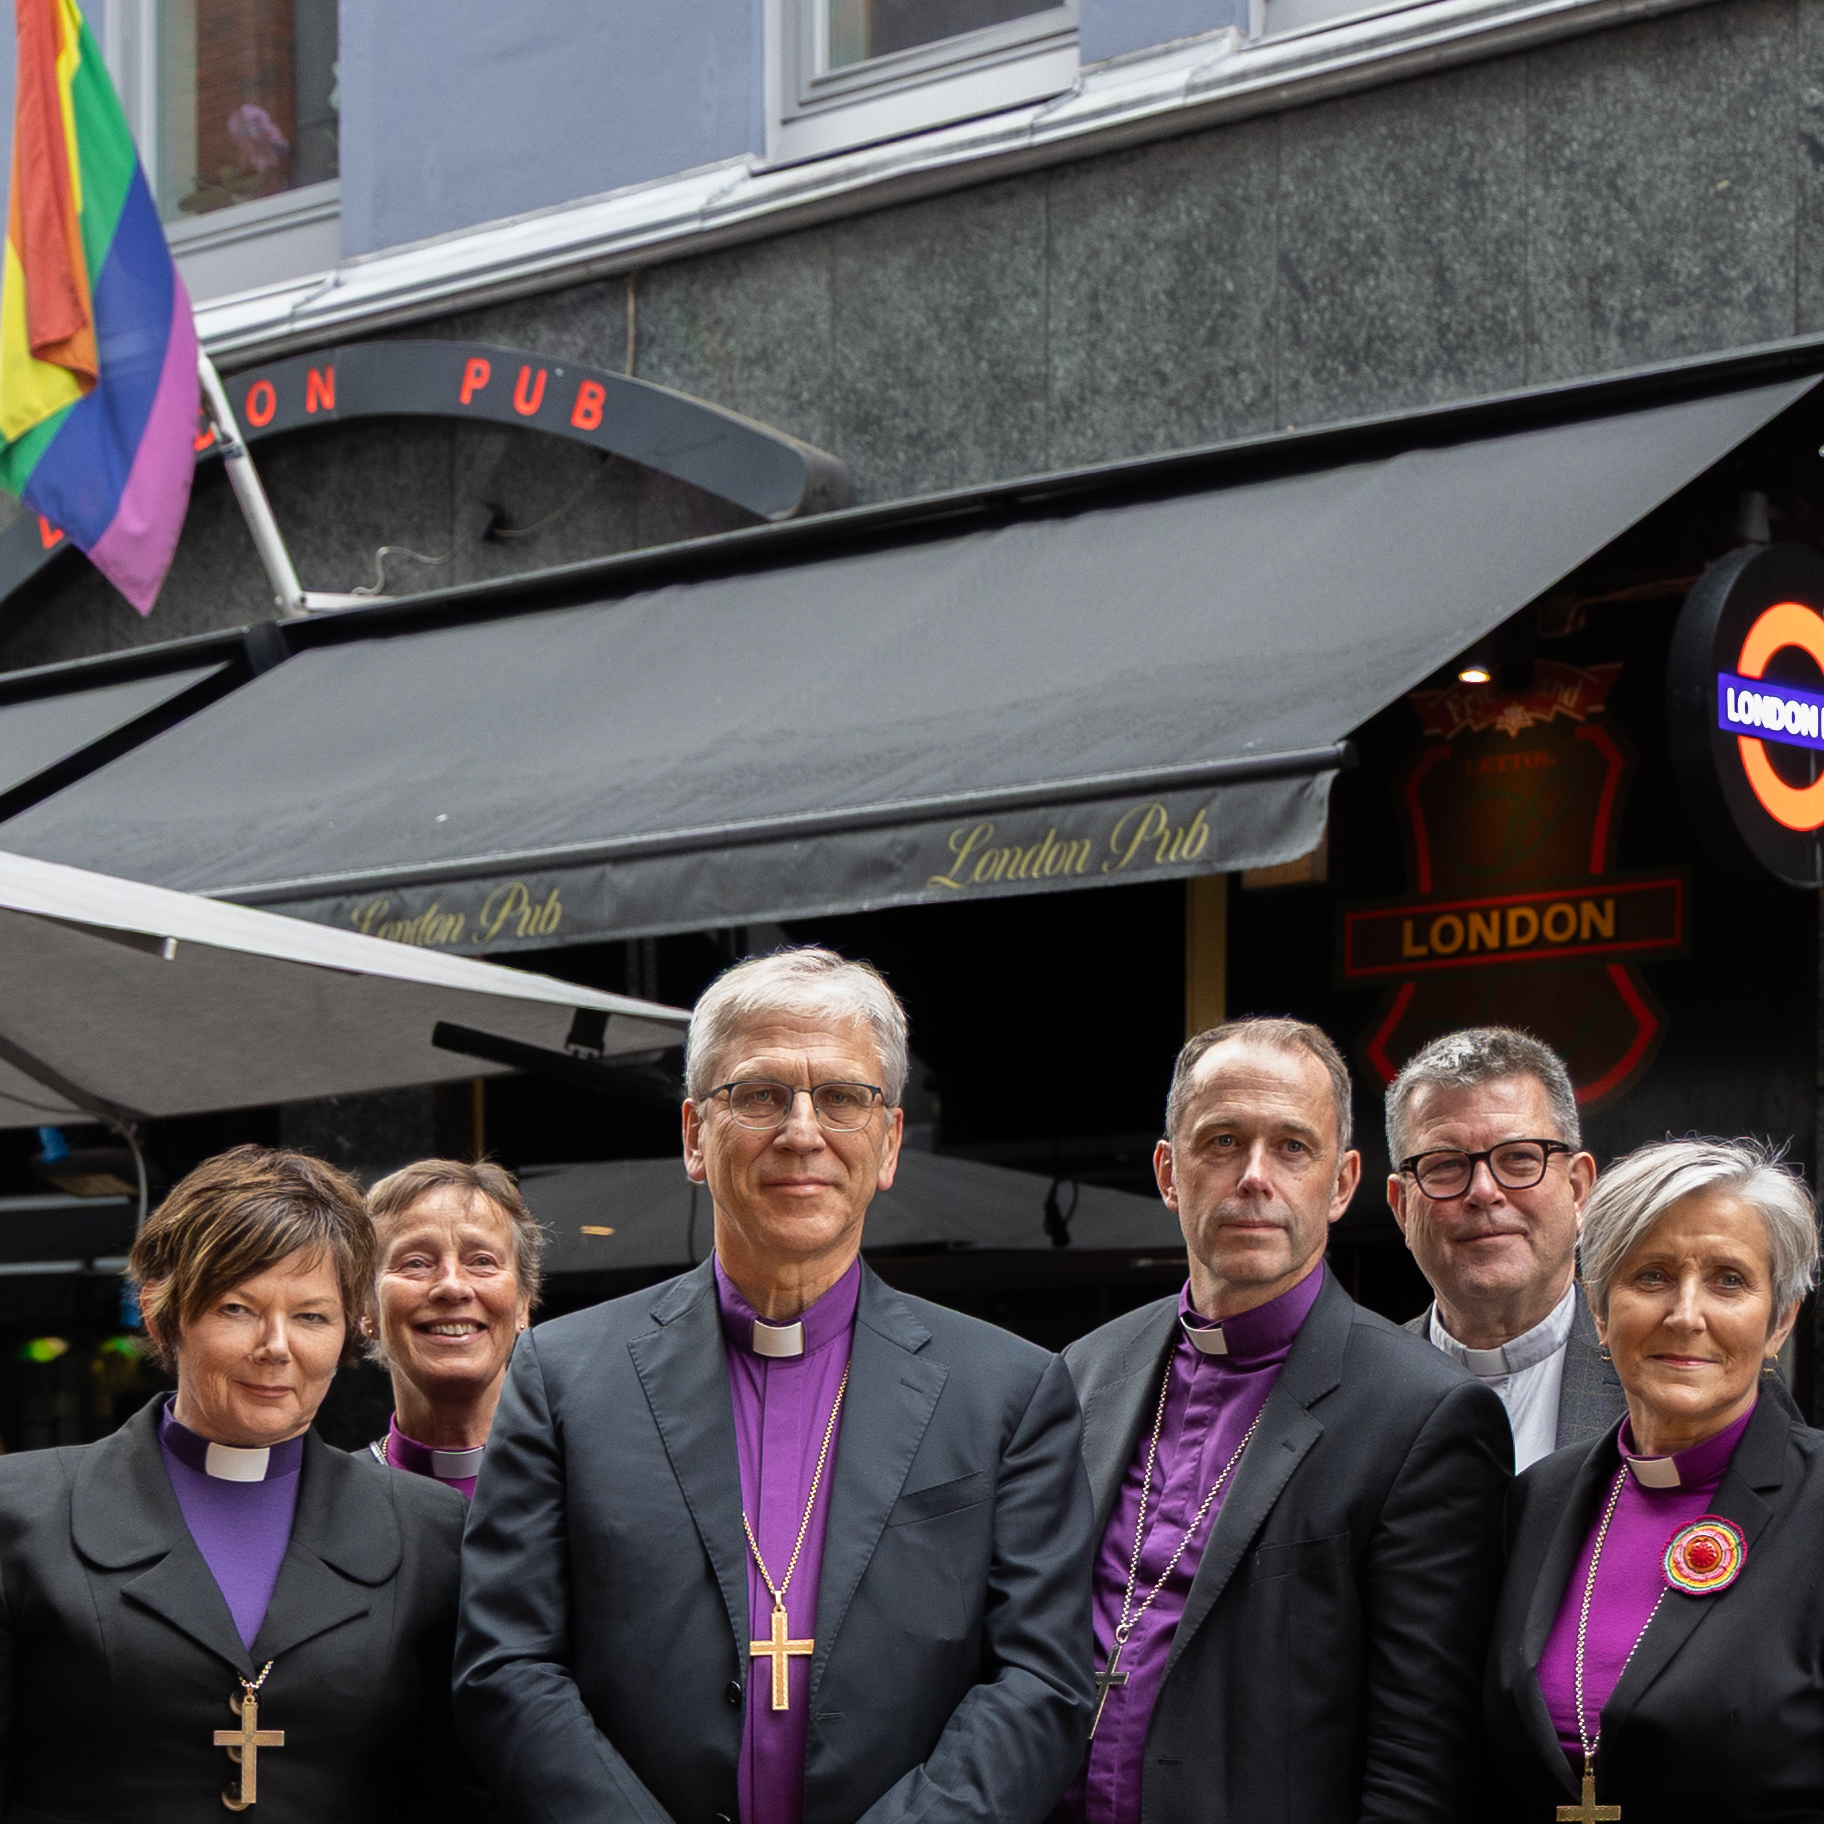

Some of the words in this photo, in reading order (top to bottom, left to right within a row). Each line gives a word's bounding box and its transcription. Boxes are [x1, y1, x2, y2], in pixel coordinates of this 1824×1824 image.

[458, 358, 606, 430] PUB
[1727, 687, 1819, 739] LONDON
[926, 821, 1092, 891] London
[1101, 802, 1210, 874] Pub
[350, 898, 466, 946] London
[471, 880, 563, 946] Pub
[1401, 898, 1616, 960] LONDON
